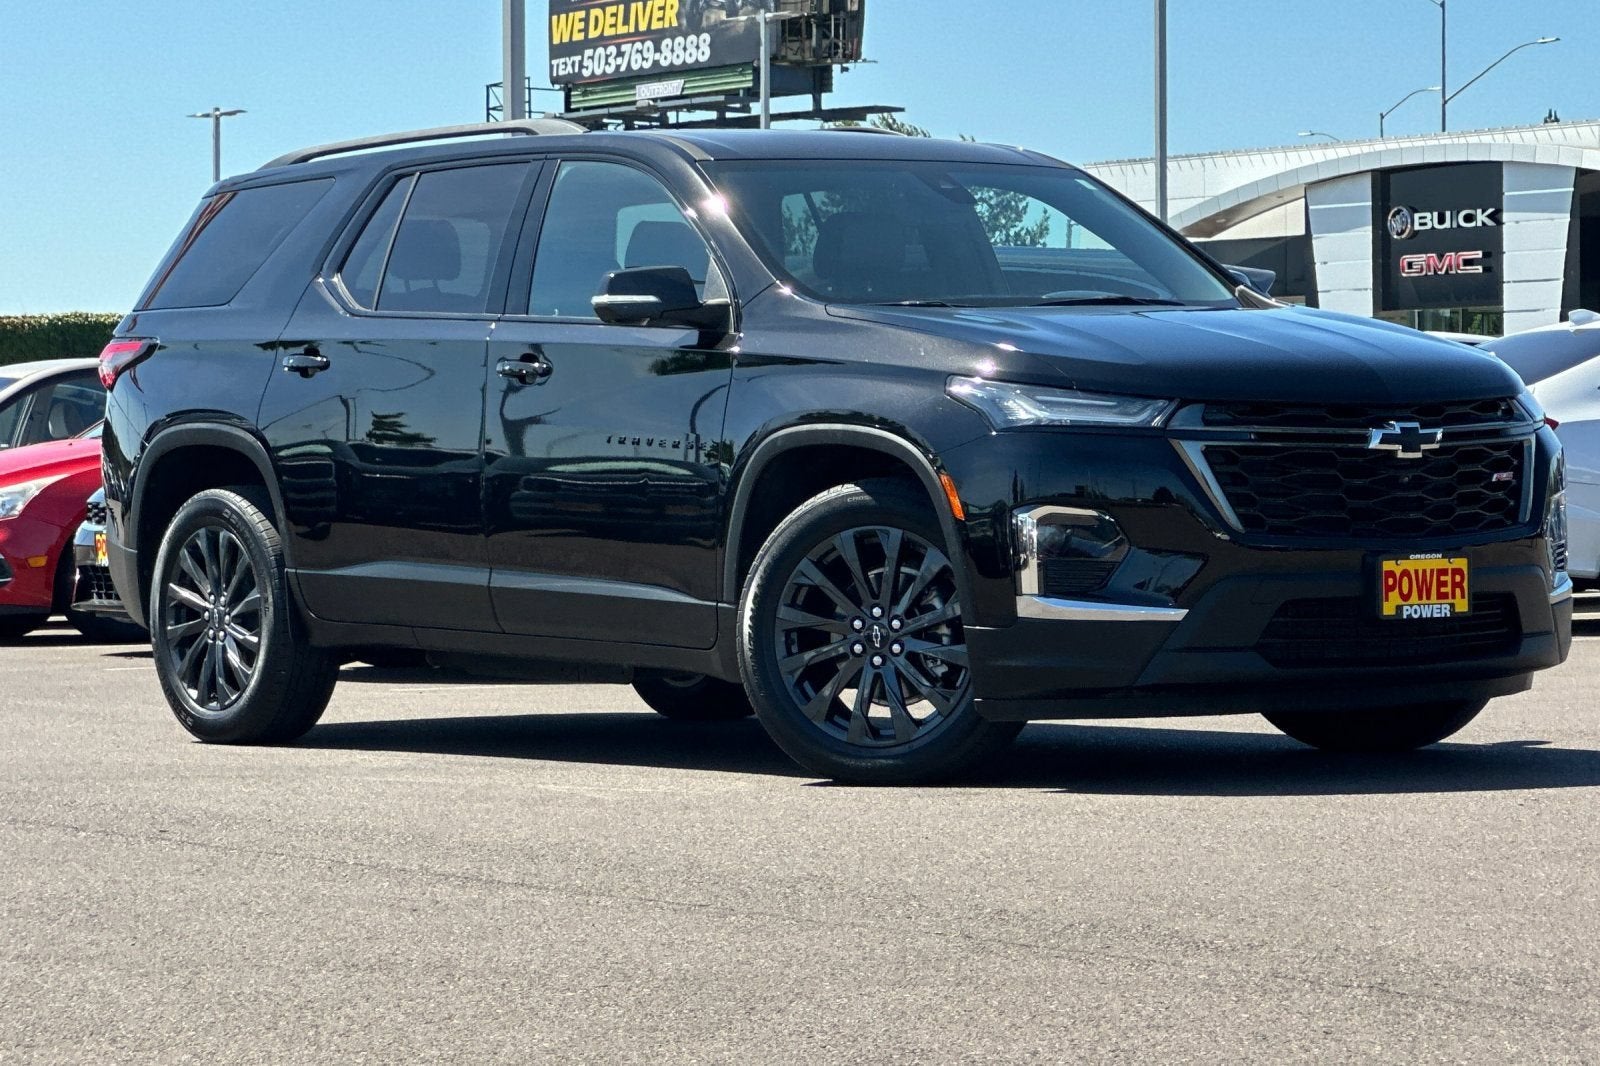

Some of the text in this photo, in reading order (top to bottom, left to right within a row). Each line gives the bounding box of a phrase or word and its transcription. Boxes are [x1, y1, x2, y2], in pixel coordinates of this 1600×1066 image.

[552, 0, 679, 44] WE DELIVER
[551, 33, 711, 77] TEXT 503-769-8888
[1414, 208, 1496, 230] BUICK
[1400, 251, 1482, 277] GMC
[1384, 567, 1466, 602] POWER
[1403, 604, 1451, 619] POWER
